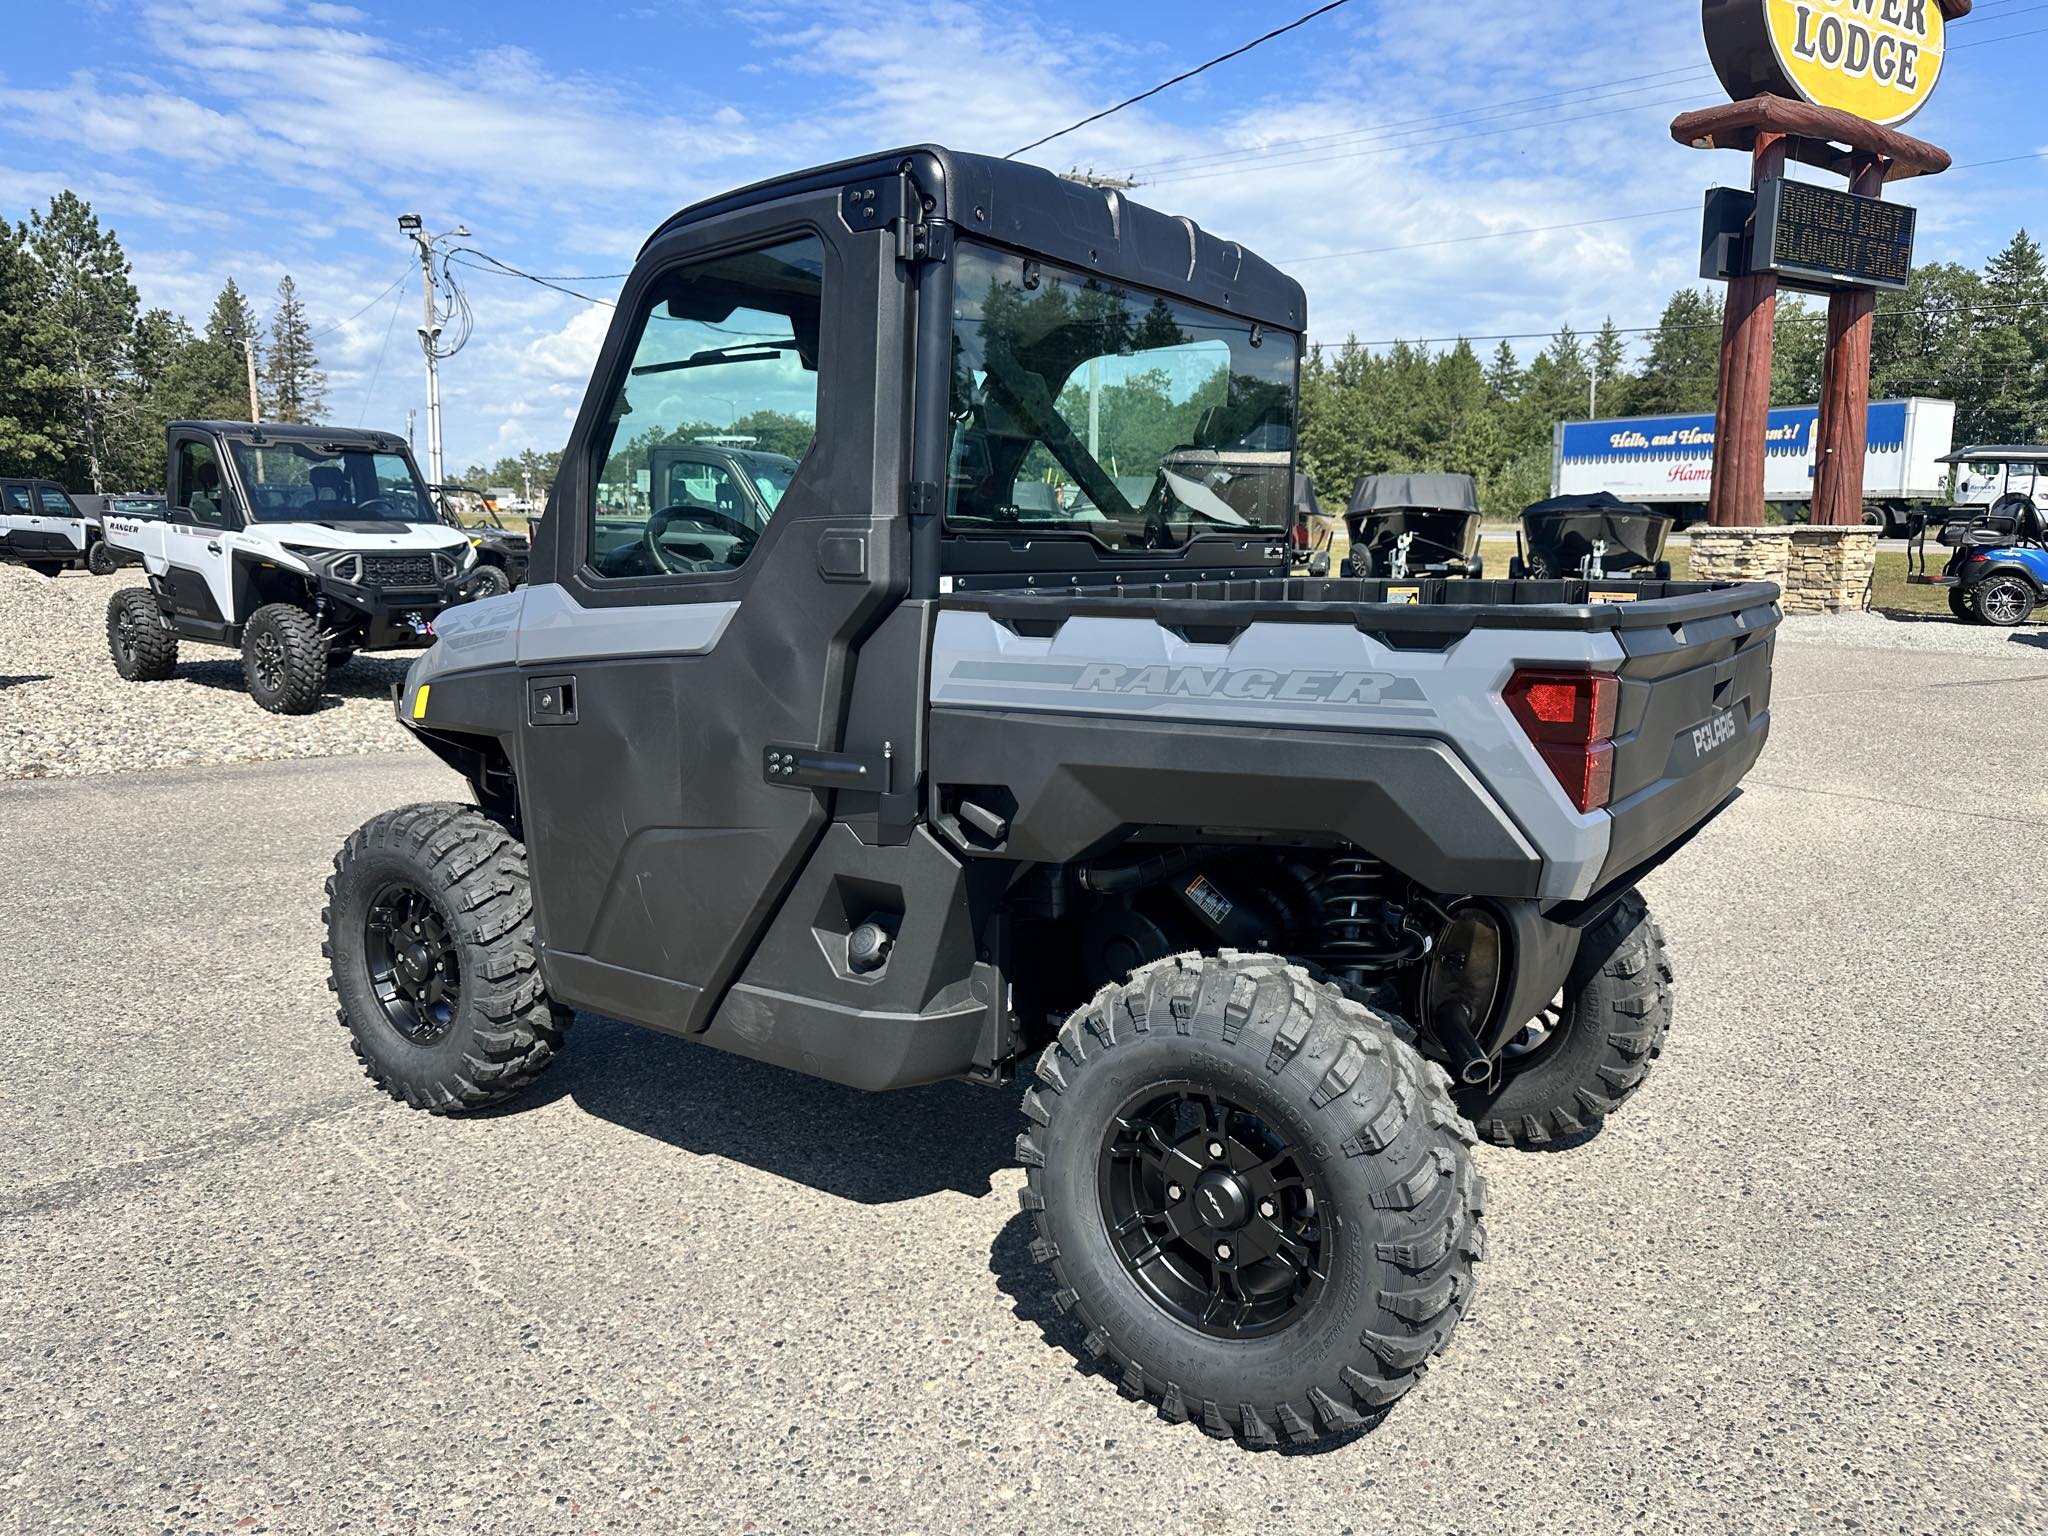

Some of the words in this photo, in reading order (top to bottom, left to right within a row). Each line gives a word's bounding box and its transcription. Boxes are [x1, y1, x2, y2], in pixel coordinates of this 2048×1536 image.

[1794, 6, 1918, 90] LODGE
[1782, 185, 1856, 232] RANGER
[1858, 202, 1904, 243] BOAT
[1775, 222, 1862, 270] BLOWOUT
[1864, 240, 1910, 278] SALE
[1610, 430, 1649, 449] Hello,
[1651, 430, 1678, 447] and
[109, 522, 139, 534] RANGER
[1072, 662, 1396, 704] RANGER
[1692, 710, 1736, 758] POLARIS
